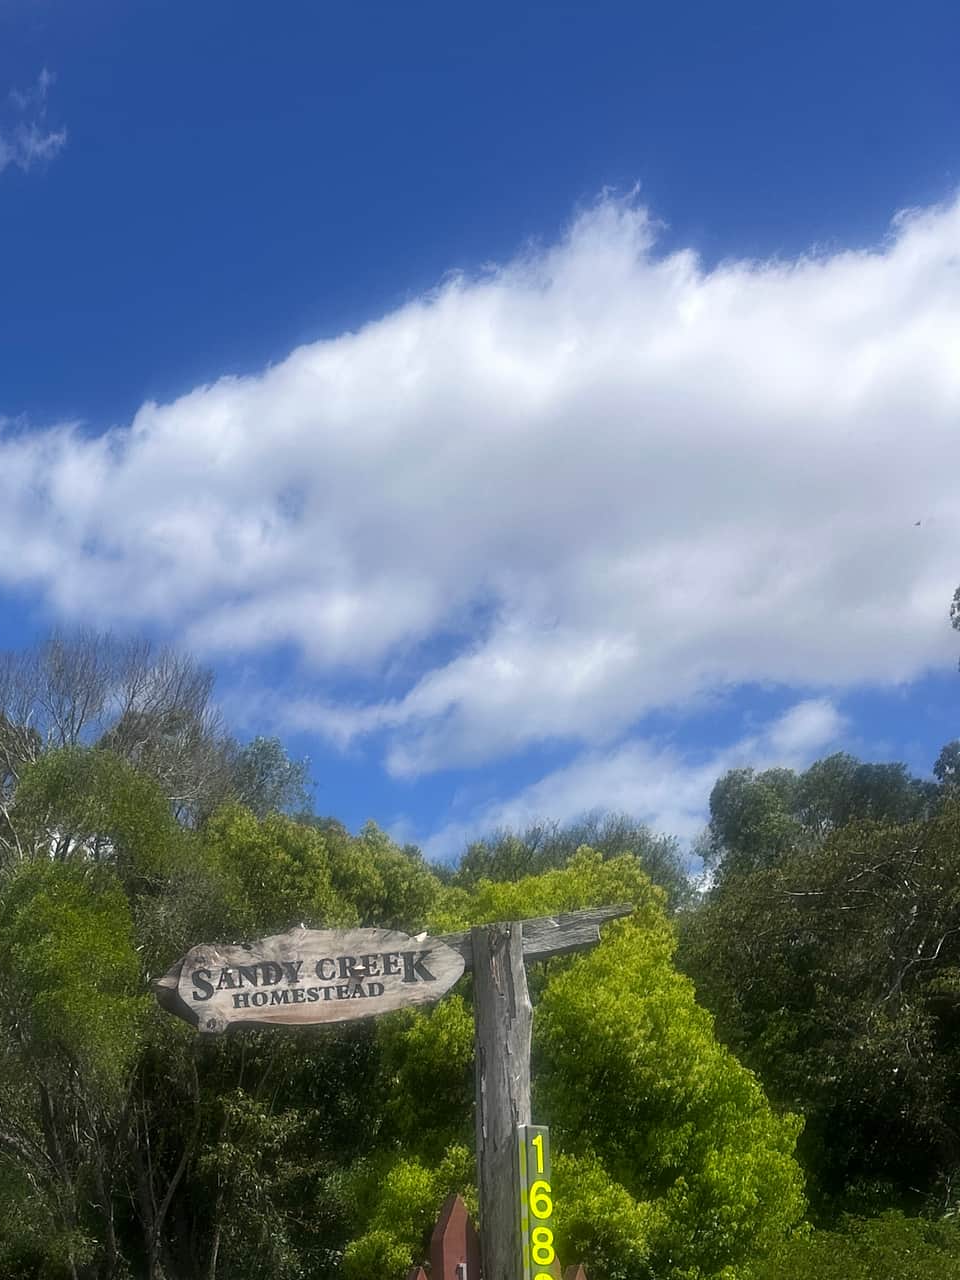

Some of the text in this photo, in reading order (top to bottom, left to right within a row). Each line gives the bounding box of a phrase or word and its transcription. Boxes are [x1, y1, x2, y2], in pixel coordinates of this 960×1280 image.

[191, 950, 437, 1001] SANDY CREEK
[232, 982, 385, 1009] HOMESTEAD
